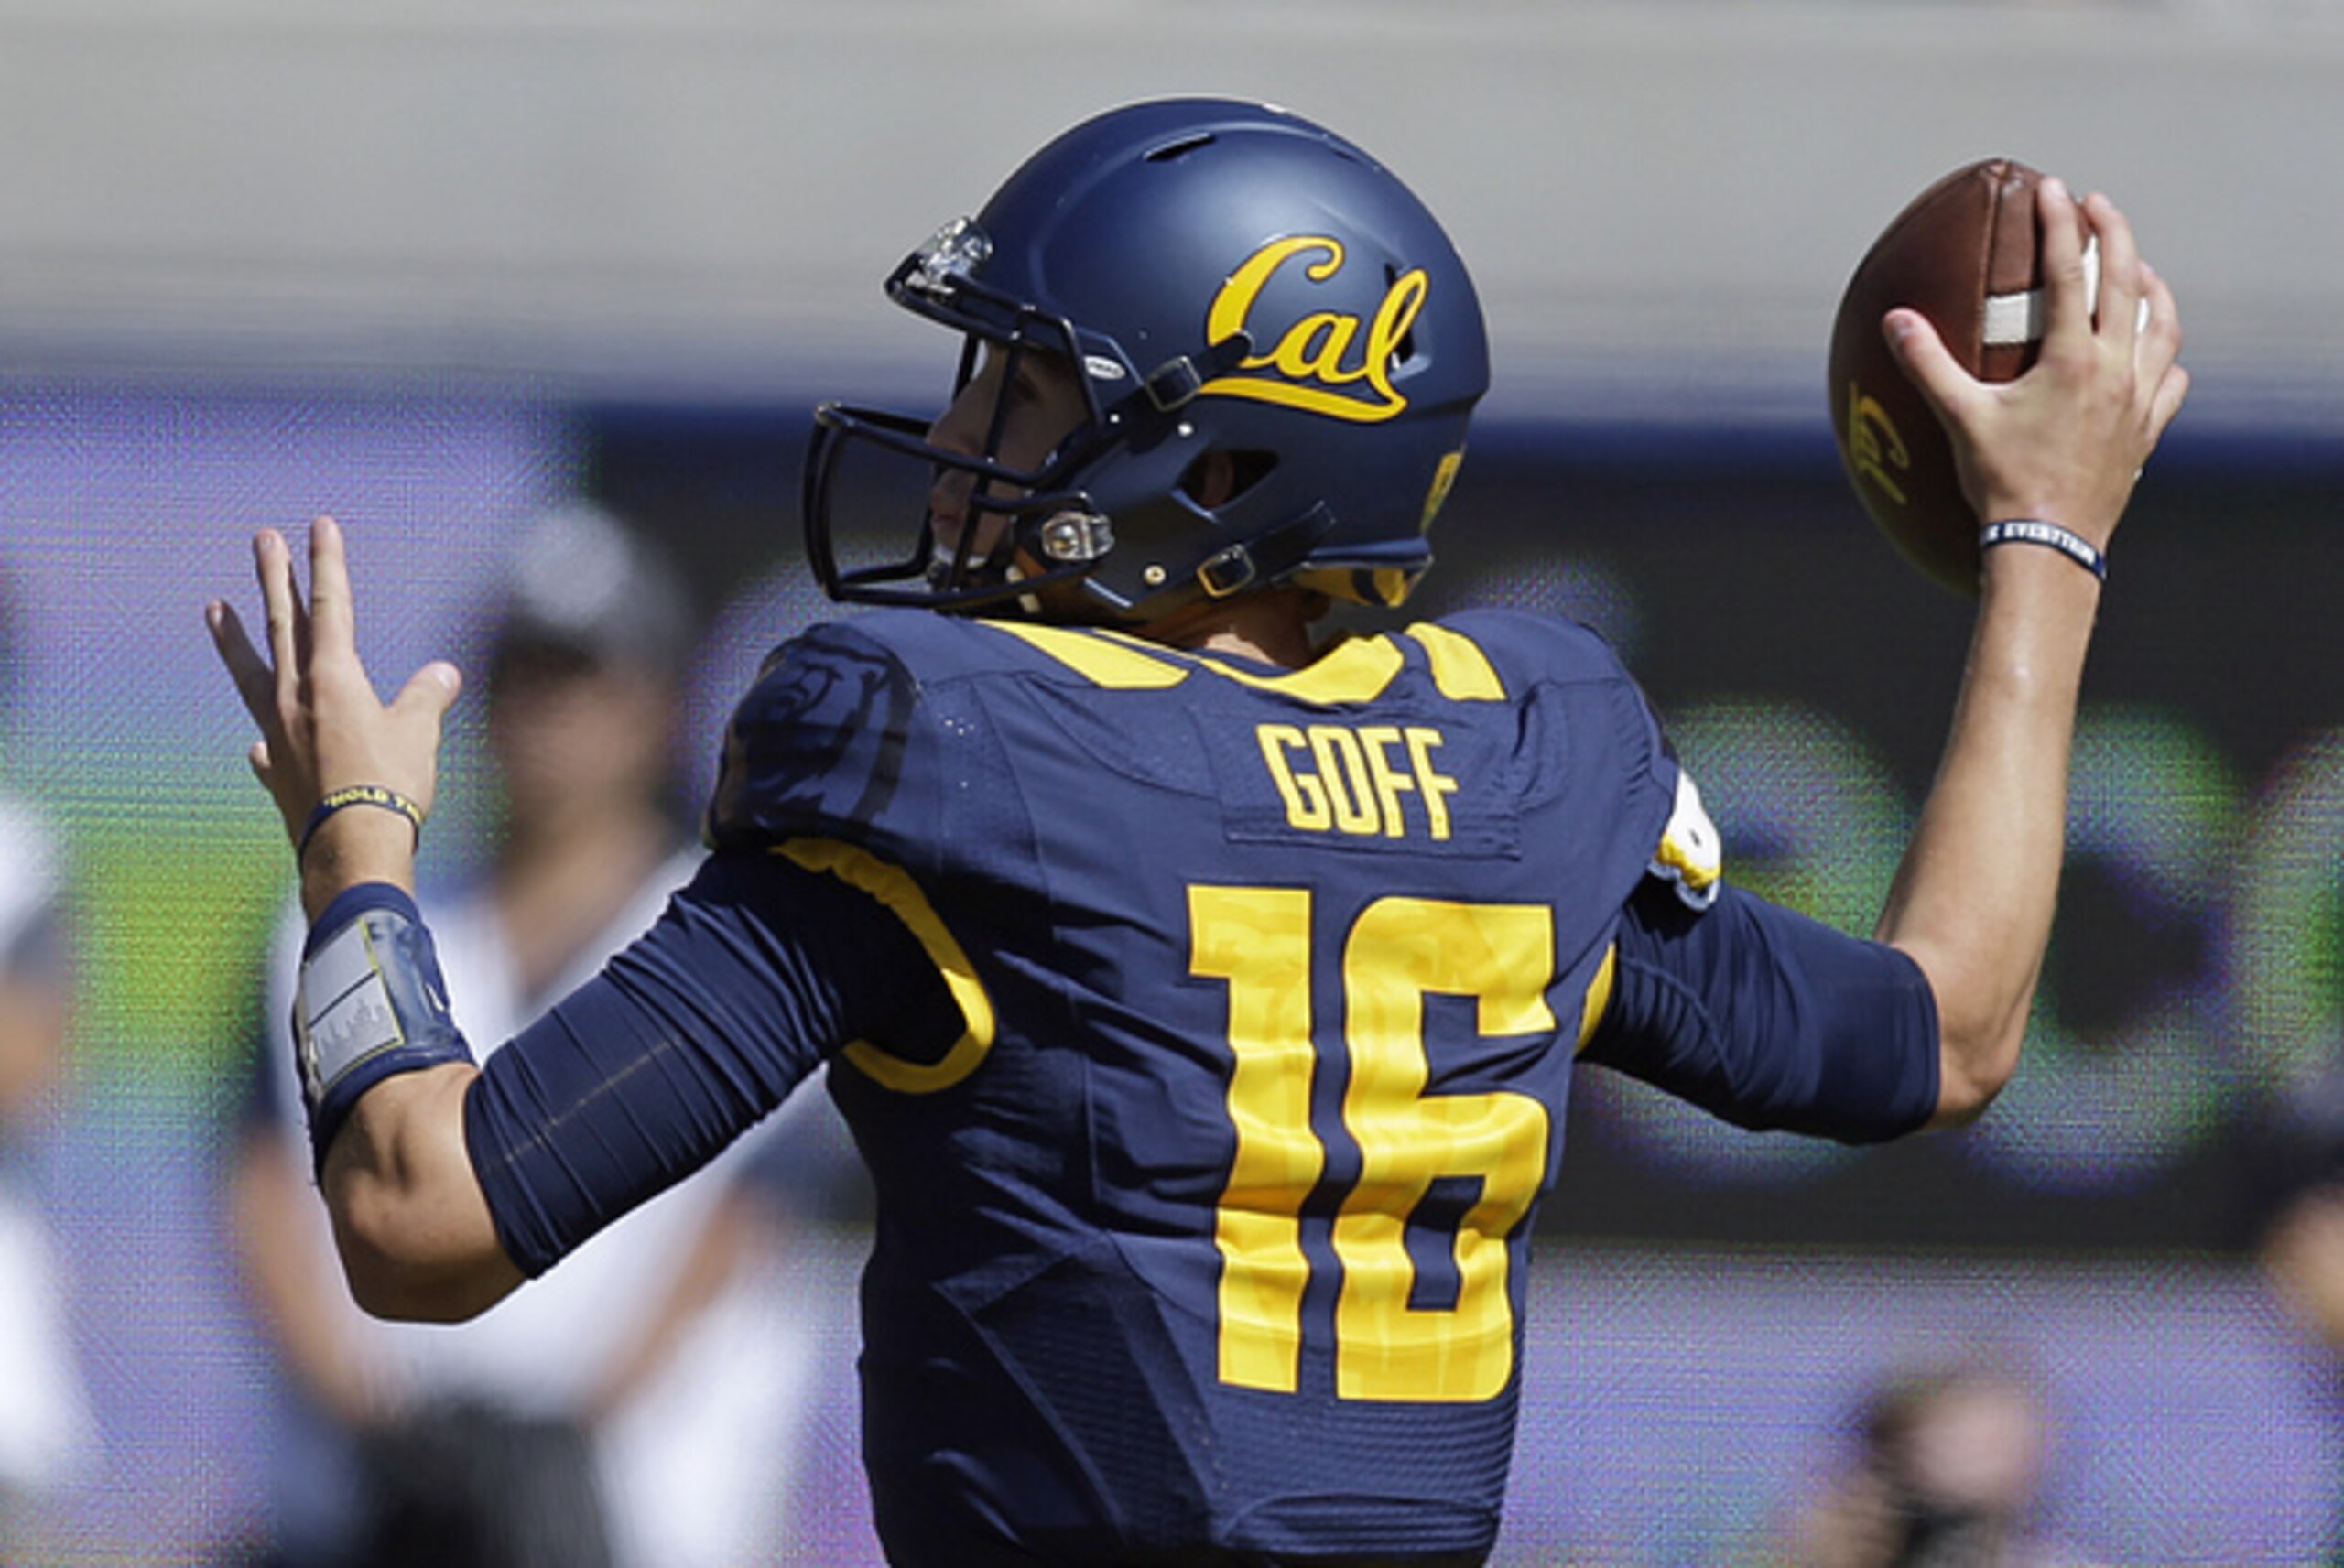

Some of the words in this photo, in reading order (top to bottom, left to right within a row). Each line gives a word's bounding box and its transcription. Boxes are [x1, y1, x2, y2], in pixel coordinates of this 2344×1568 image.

[1200, 236, 1429, 422] Cal
[1256, 724, 1458, 839] GOFF
[1186, 883, 1557, 1402] 16
